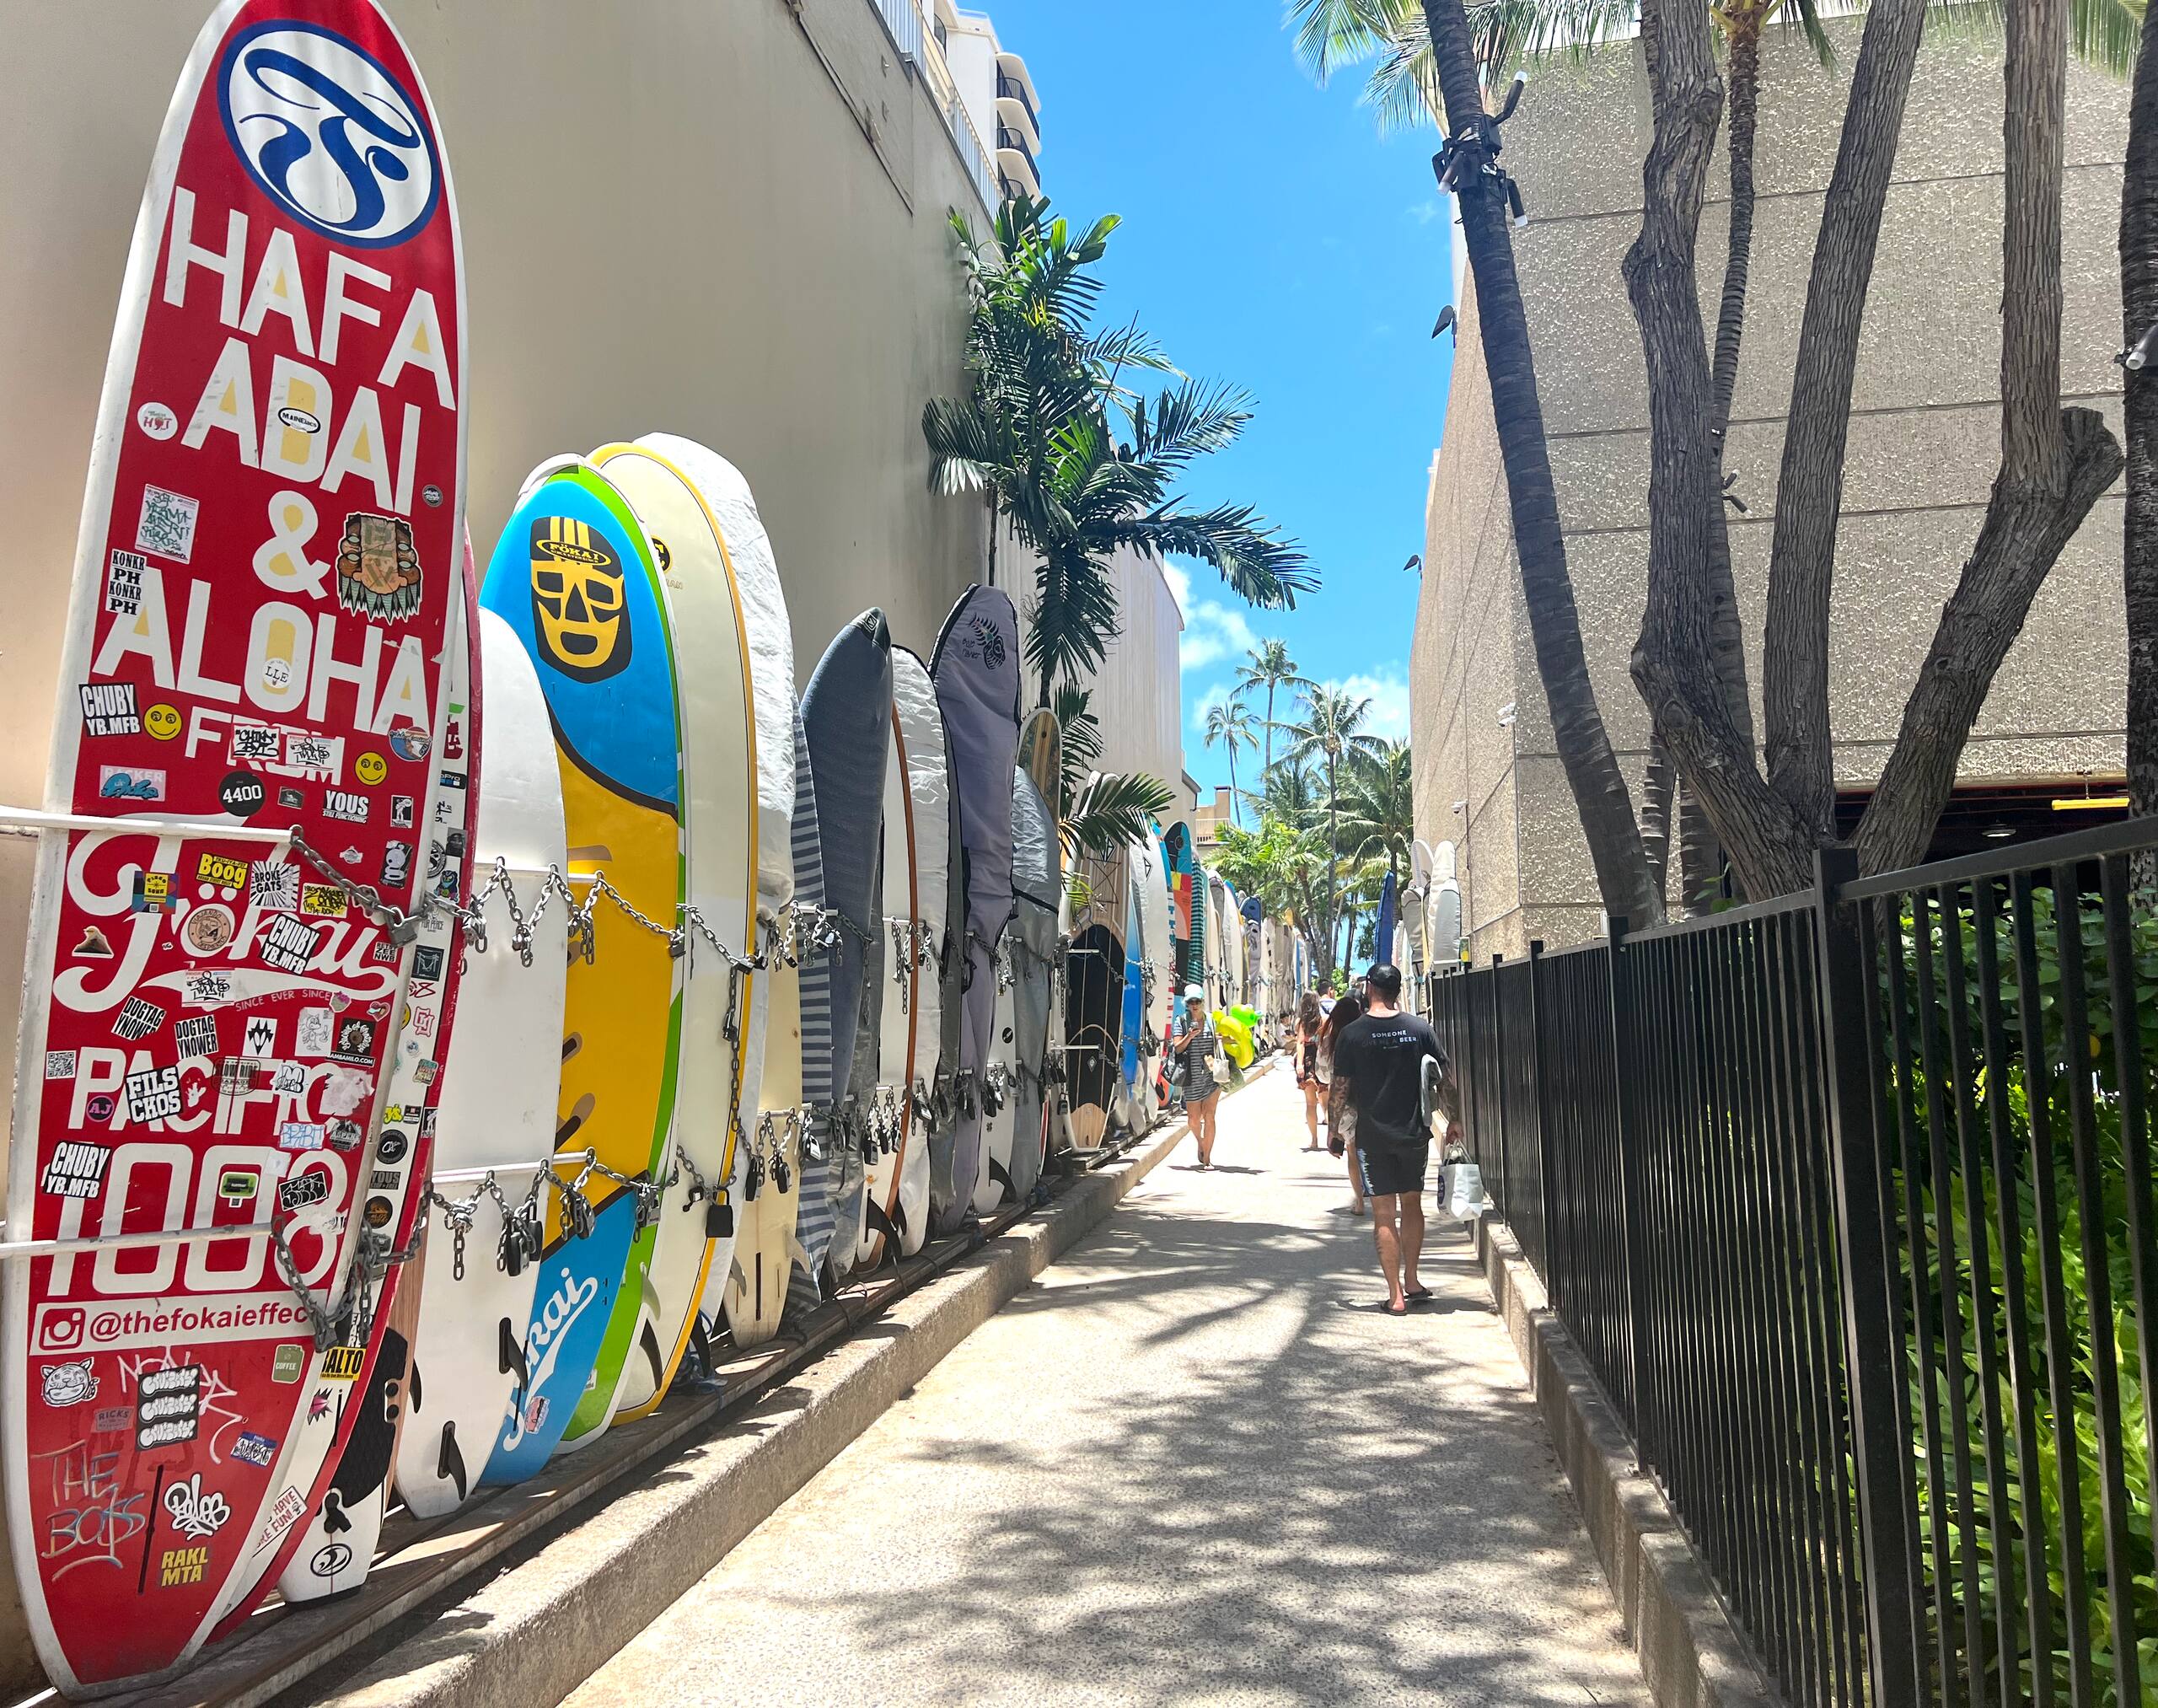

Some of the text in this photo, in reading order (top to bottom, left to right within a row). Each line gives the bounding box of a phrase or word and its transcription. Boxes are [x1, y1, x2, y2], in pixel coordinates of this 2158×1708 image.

[164, 185, 456, 411] HAFA
[180, 336, 421, 517] ADAI
[252, 489, 330, 599] &
[550, 542, 599, 560] FÖKAI
[112, 551, 145, 571] KONKR
[113, 567, 142, 585] PH
[108, 581, 142, 601] KONKR
[110, 598, 138, 615] PH
[92, 568, 431, 735] ALOHA
[266, 666, 288, 683] LLE
[82, 685, 136, 717] CHUBY
[86, 717, 141, 736] YB.MFB
[223, 785, 262, 803] 4400
[325, 789, 369, 816] YOUS
[199, 853, 247, 889] Boog
[255, 870, 281, 884] BROKE
[256, 880, 282, 894] GATS
[268, 916, 320, 959] CHUBY
[261, 943, 307, 975] YB.MFB
[374, 953, 395, 962] NWB
[122, 997, 167, 1028] DOGTAG
[235, 989, 331, 1012] SINCE EVER SINCE
[175, 1015, 215, 1039] DOGTAG
[1372, 1029, 1407, 1039] SOMEONE
[177, 1033, 218, 1060] YNOWER
[126, 1066, 179, 1100] FILS
[89, 1103, 113, 1114] AJ
[51, 1142, 111, 1179] CHUBY
[46, 1174, 100, 1199] YB.MFB
[373, 1172, 400, 1184] YOUS
[40, 1141, 348, 1297] 1008
[90, 1302, 310, 1343] @thefokaieffec
[275, 1362, 297, 1372] COFFEE
[98, 1409, 130, 1420] RICKS
[30, 1439, 120, 1507] THE
[272, 1490, 297, 1516] HAVE
[272, 1510, 293, 1533] FUN!
[161, 1546, 208, 1570] RAKL
[161, 1565, 203, 1587] MTA
